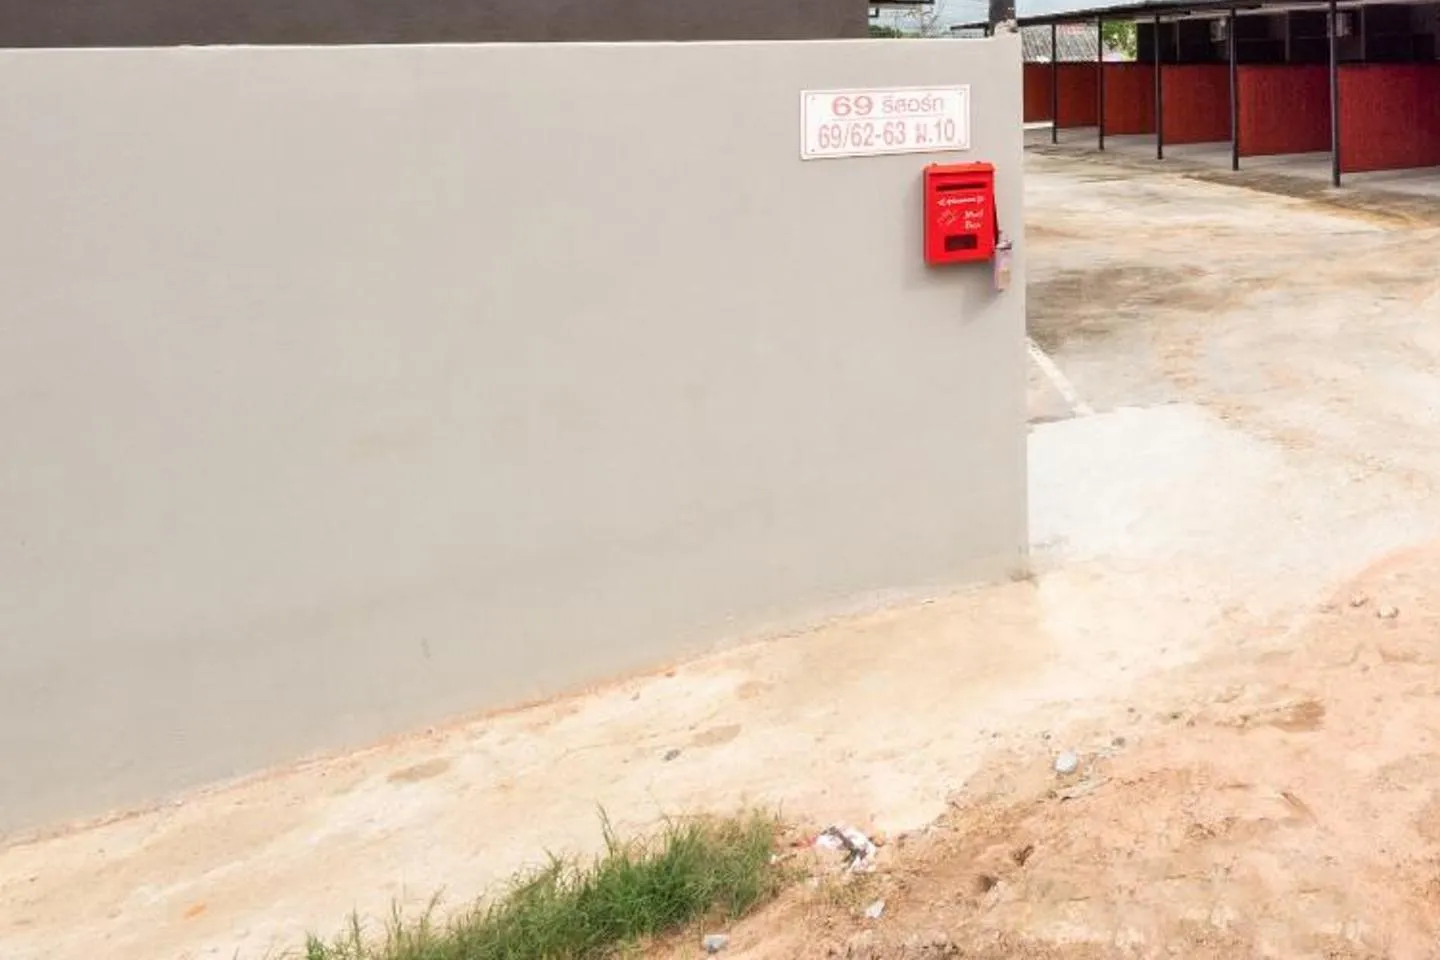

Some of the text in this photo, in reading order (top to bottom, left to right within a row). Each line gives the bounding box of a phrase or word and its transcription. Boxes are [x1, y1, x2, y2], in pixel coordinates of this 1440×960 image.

[832, 95, 873, 116] 69
[818, 118, 956, 149] 69/62-63 ม.10
